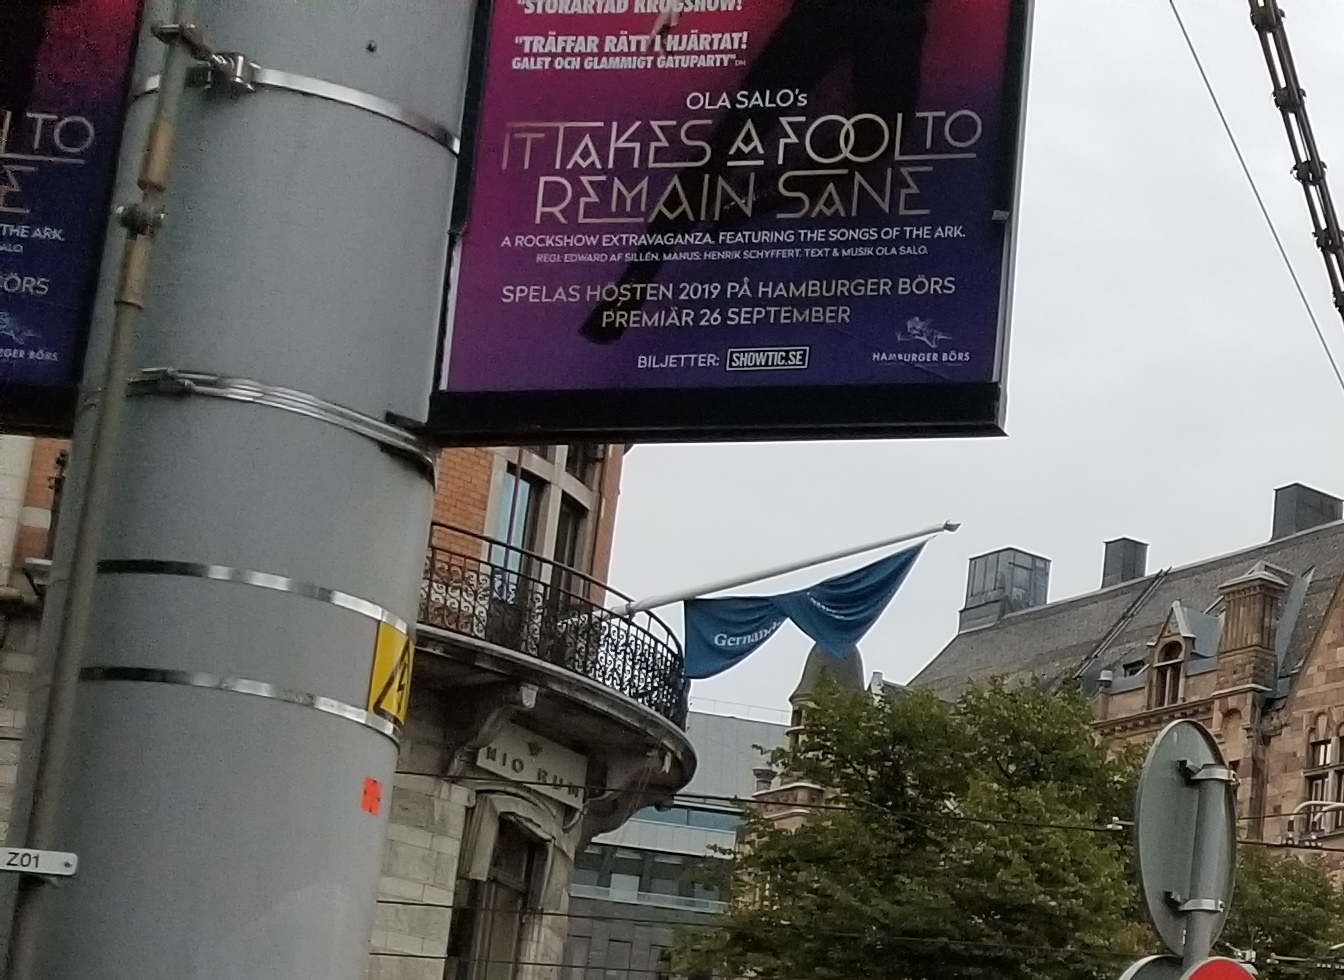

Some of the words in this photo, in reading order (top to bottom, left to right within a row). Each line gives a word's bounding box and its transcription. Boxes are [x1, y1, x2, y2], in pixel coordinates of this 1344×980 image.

[604, 31, 650, 53] RÄTT
[666, 29, 748, 52] HJÄRTAT!
[512, 57, 551, 70] GALET
[555, 56, 580, 70] OCH
[584, 55, 653, 69] GLAMMIGT
[686, 92, 732, 110] OLA
[735, 88, 808, 109] SALO's
[507, 119, 713, 169] TAKES
[726, 118, 764, 166] A
[777, 112, 976, 164] FOOL
[915, 109, 982, 149] TO
[534, 173, 755, 224] REMAIN
[776, 166, 933, 219] SANE
[501, 235, 512, 247] A
[515, 234, 599, 248] ROCKSHOW
[602, 232, 715, 246] EXTRAVAGANZA.
[718, 230, 794, 245] FEATURING
[799, 229, 826, 242] THE
[828, 227, 878, 241] SONGS
[881, 227, 901, 240] OF
[904, 226, 932, 240] THE
[934, 225, 966, 239] ARK.
[703, 250, 741, 260] HENRIK
[805, 248, 831, 258] TEXT
[832, 248, 839, 257] &
[842, 247, 874, 257] MUSIK
[875, 246, 897, 256] OLA
[501, 285, 581, 303] SPELAS
[586, 281, 673, 302] HÖSTEN
[679, 283, 721, 299] 2019
[726, 276, 752, 299] PÅ
[758, 279, 893, 298] HAMBURGER
[898, 274, 956, 295] BÖRS
[602, 306, 694, 327] PREMIÄR
[699, 309, 722, 325] 26
[726, 307, 850, 325] SEPTEMBER
[637, 353, 720, 368] BILJETTER:
[731, 350, 804, 367] SHOWTIC.SE
[6, 851, 40, 868] Z01
